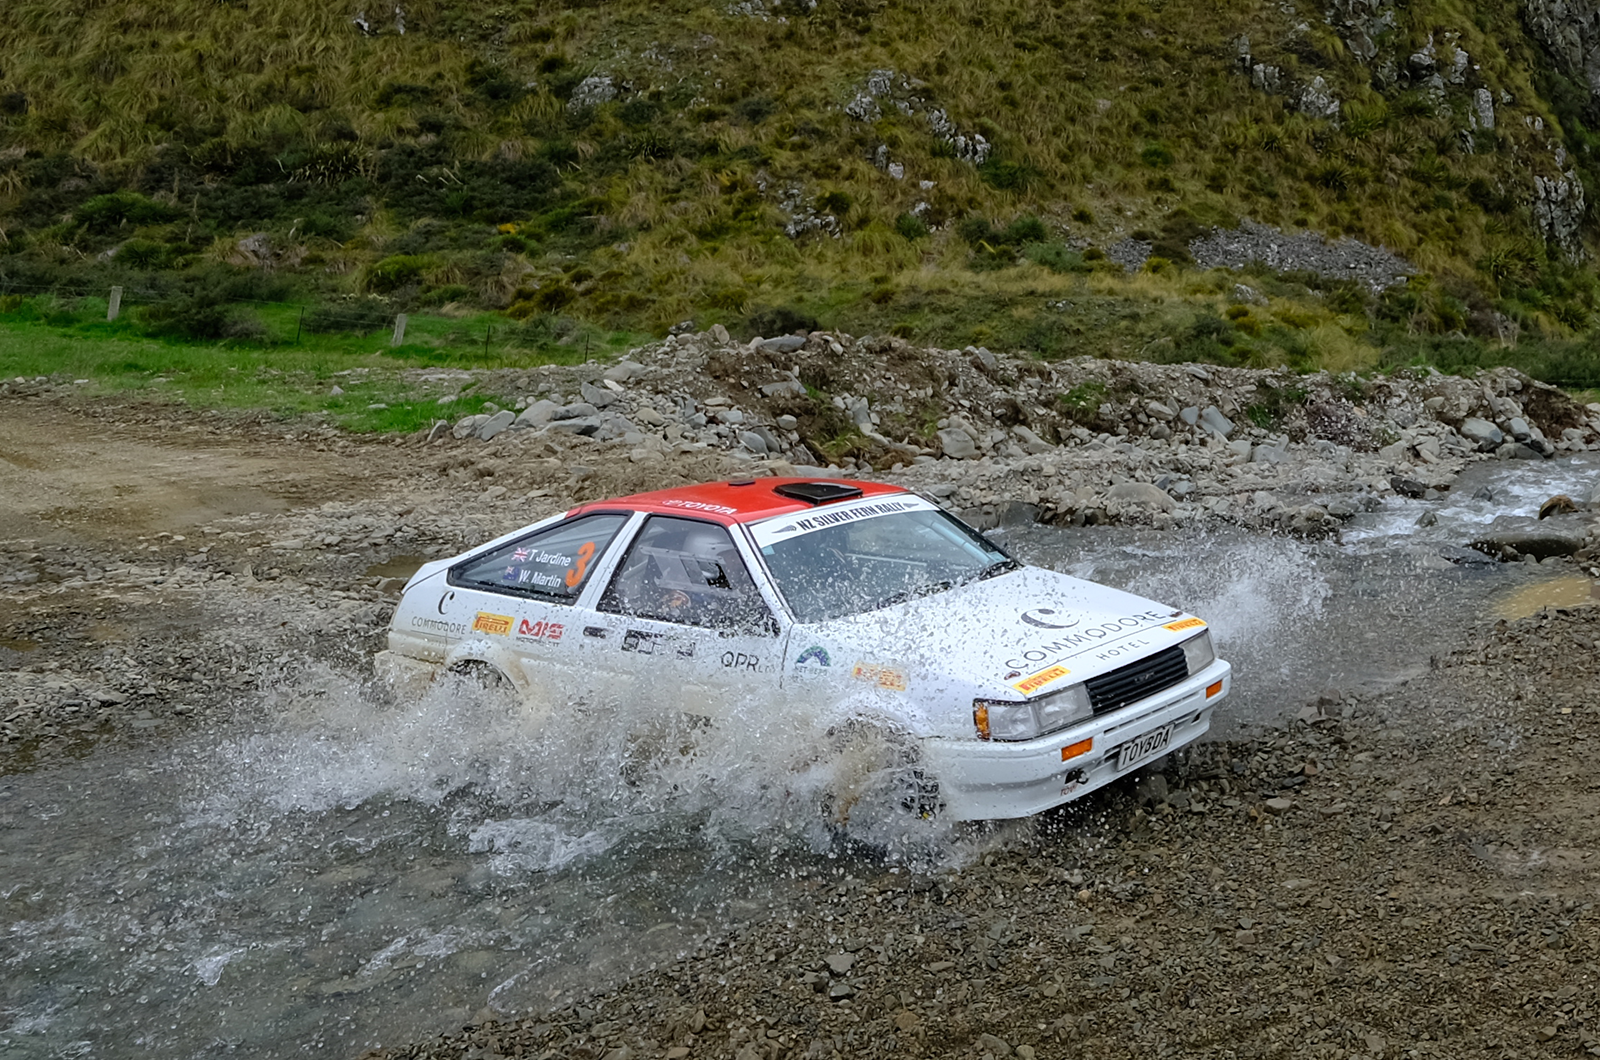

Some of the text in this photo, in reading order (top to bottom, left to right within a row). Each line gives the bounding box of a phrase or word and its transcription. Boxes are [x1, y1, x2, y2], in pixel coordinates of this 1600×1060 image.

[676, 500, 738, 515] TOYOTA
[798, 501, 906, 532] NZ SILVER FERN RALLY
[529, 549, 571, 567] T Jardine
[565, 541, 595, 587] 3
[519, 569, 562, 588] W. Martin
[411, 616, 467, 634] COMMODORE
[1005, 610, 1167, 670] COMMODORE
[1096, 638, 1150, 662] HOTEL
[720, 650, 757, 673] QPR
